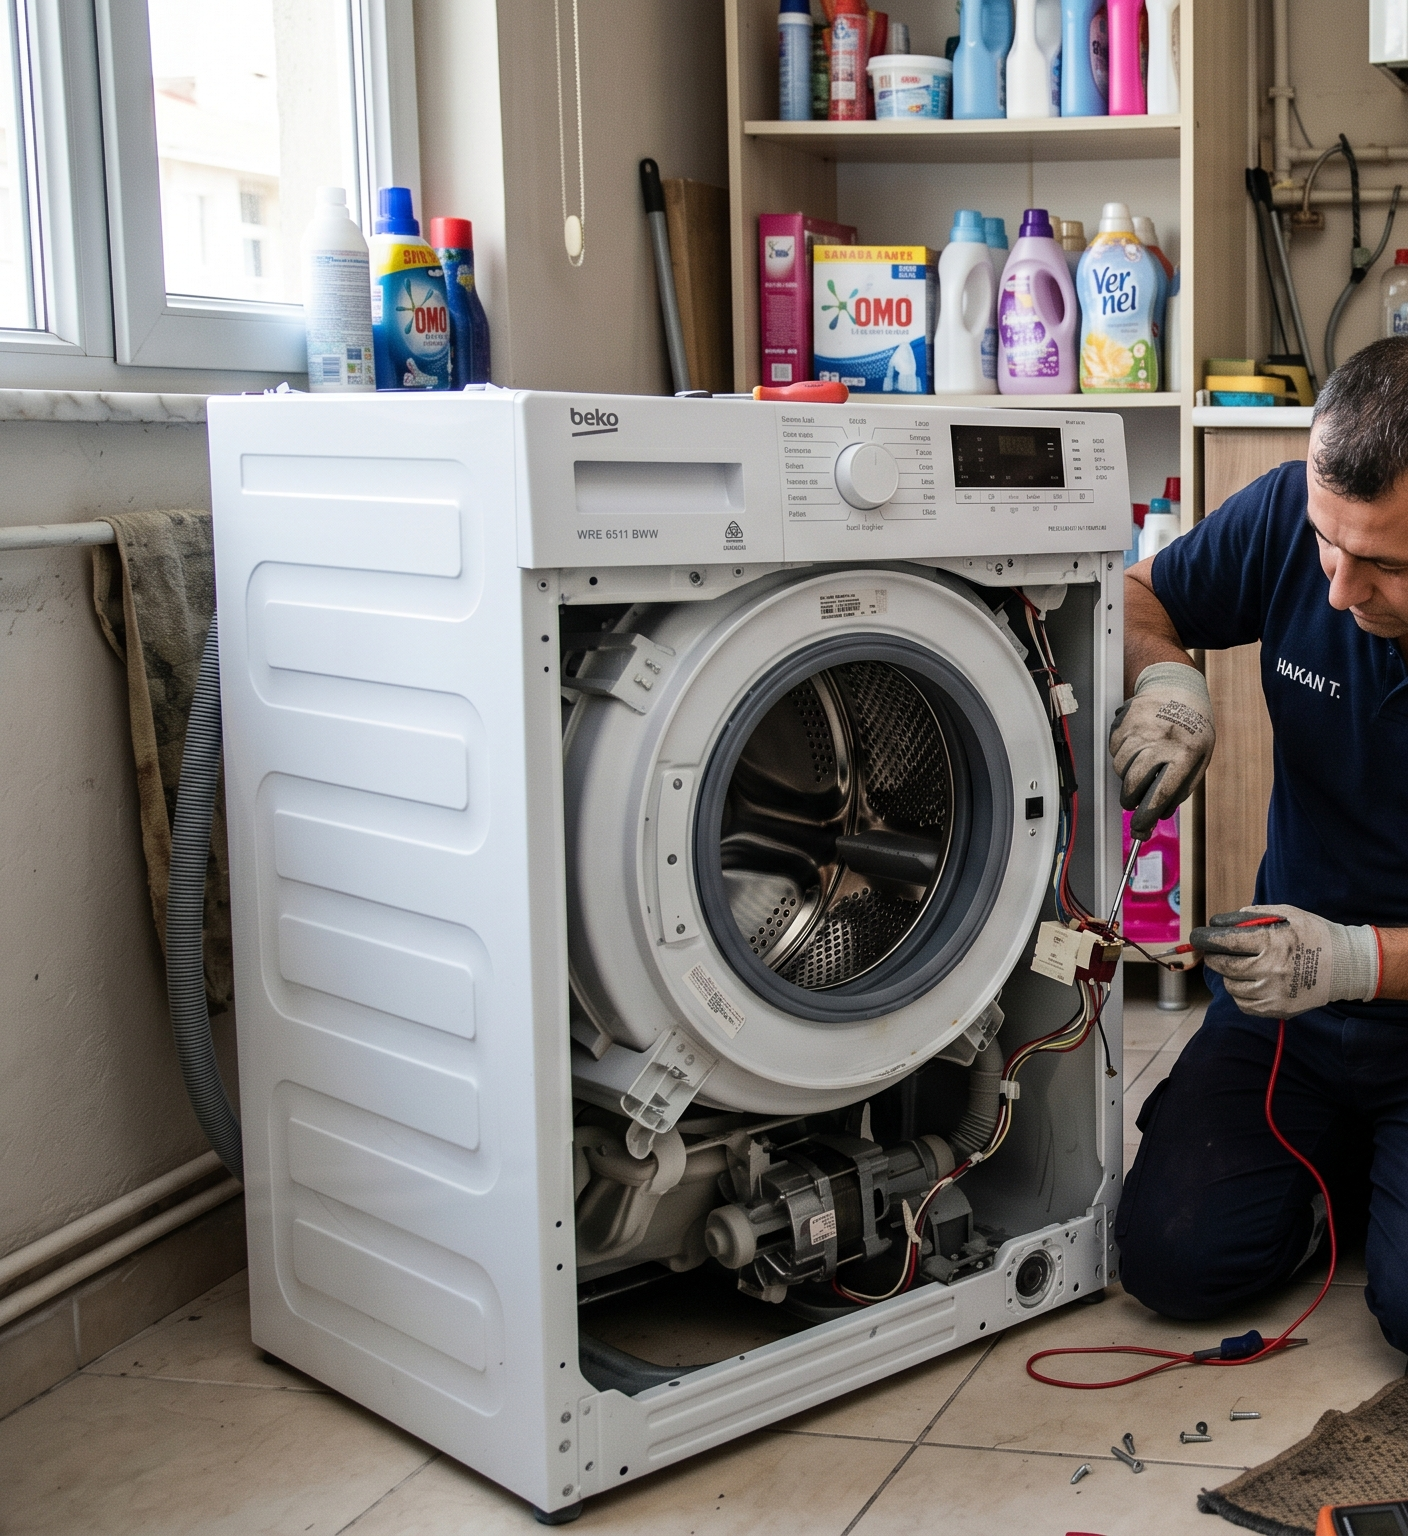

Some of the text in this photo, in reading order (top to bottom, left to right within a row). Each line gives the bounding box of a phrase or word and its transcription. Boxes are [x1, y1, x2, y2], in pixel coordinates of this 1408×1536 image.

[1092, 266, 1132, 295] Ver
[854, 297, 912, 328] OMO
[1102, 285, 1137, 316] nel
[414, 306, 447, 334] OMO
[570, 407, 619, 427] beko
[577, 529, 659, 540] WRE 6511 BWW
[1276, 657, 1341, 699] HAKAN T.
